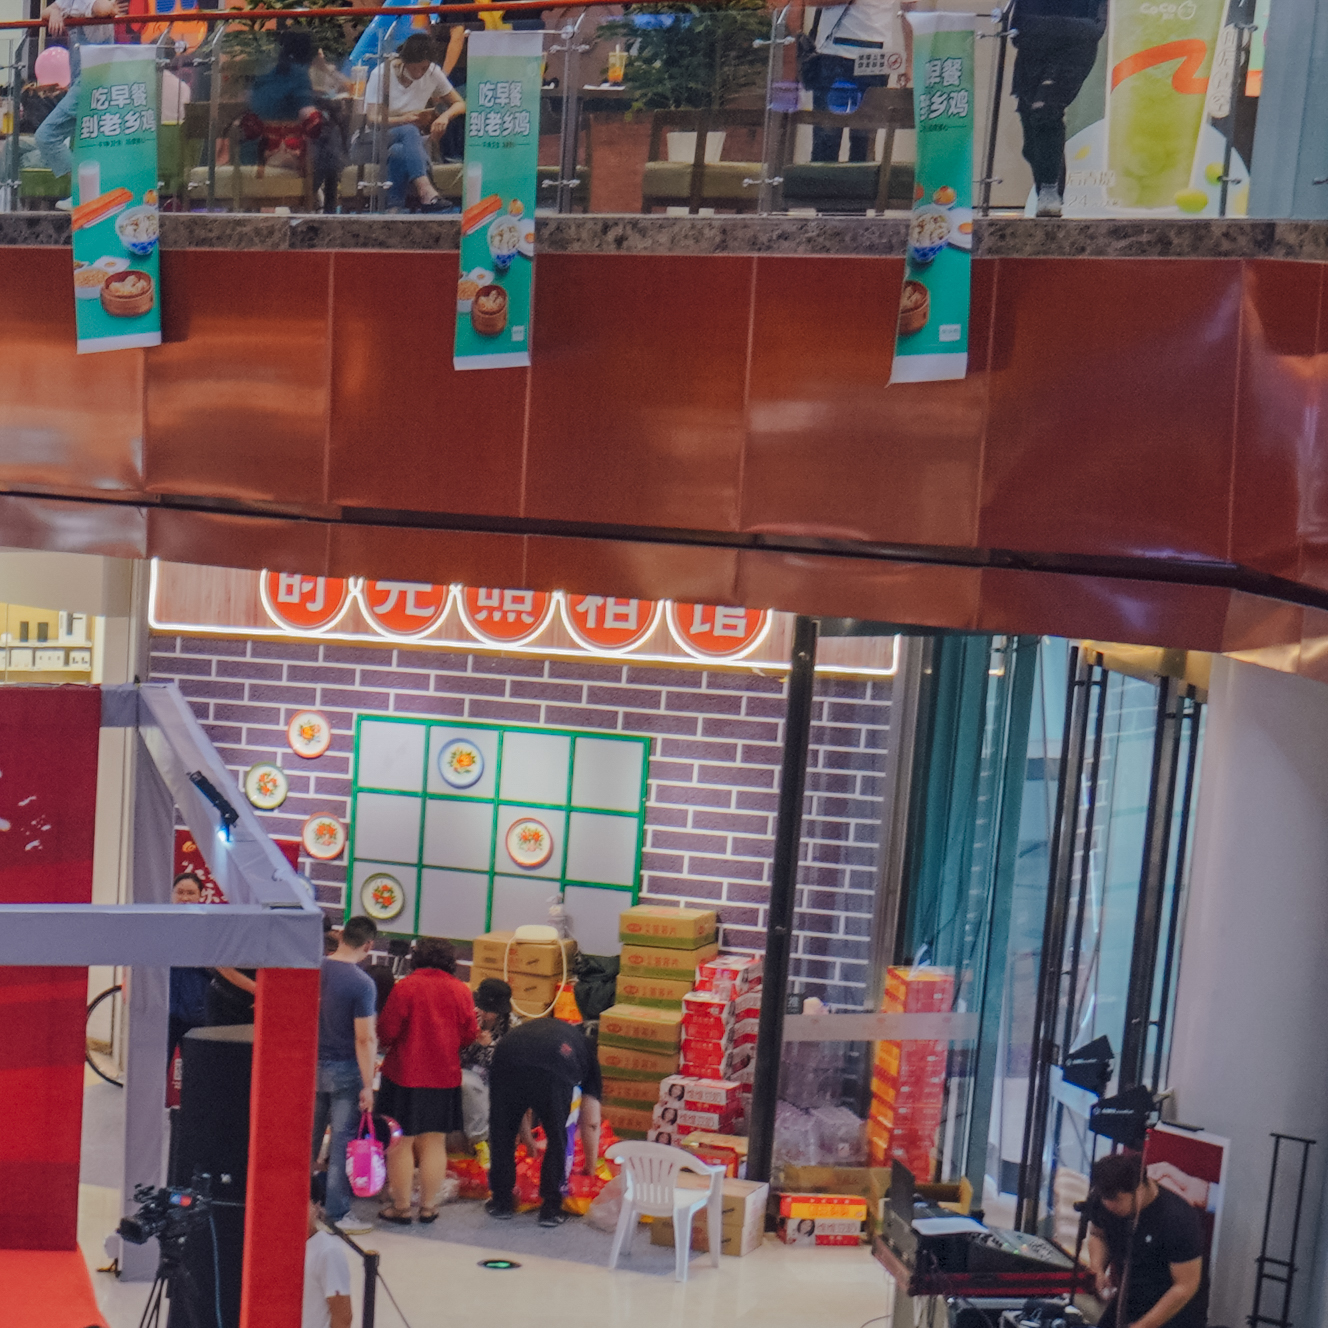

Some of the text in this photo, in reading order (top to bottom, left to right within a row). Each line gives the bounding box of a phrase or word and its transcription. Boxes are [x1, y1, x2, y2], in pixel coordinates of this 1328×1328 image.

[91, 82, 147, 111] 吃早餐
[478, 81, 523, 107] 吃早餐
[80, 109, 156, 139] 到老乡鸡
[469, 110, 530, 136] 到老乡鸡
